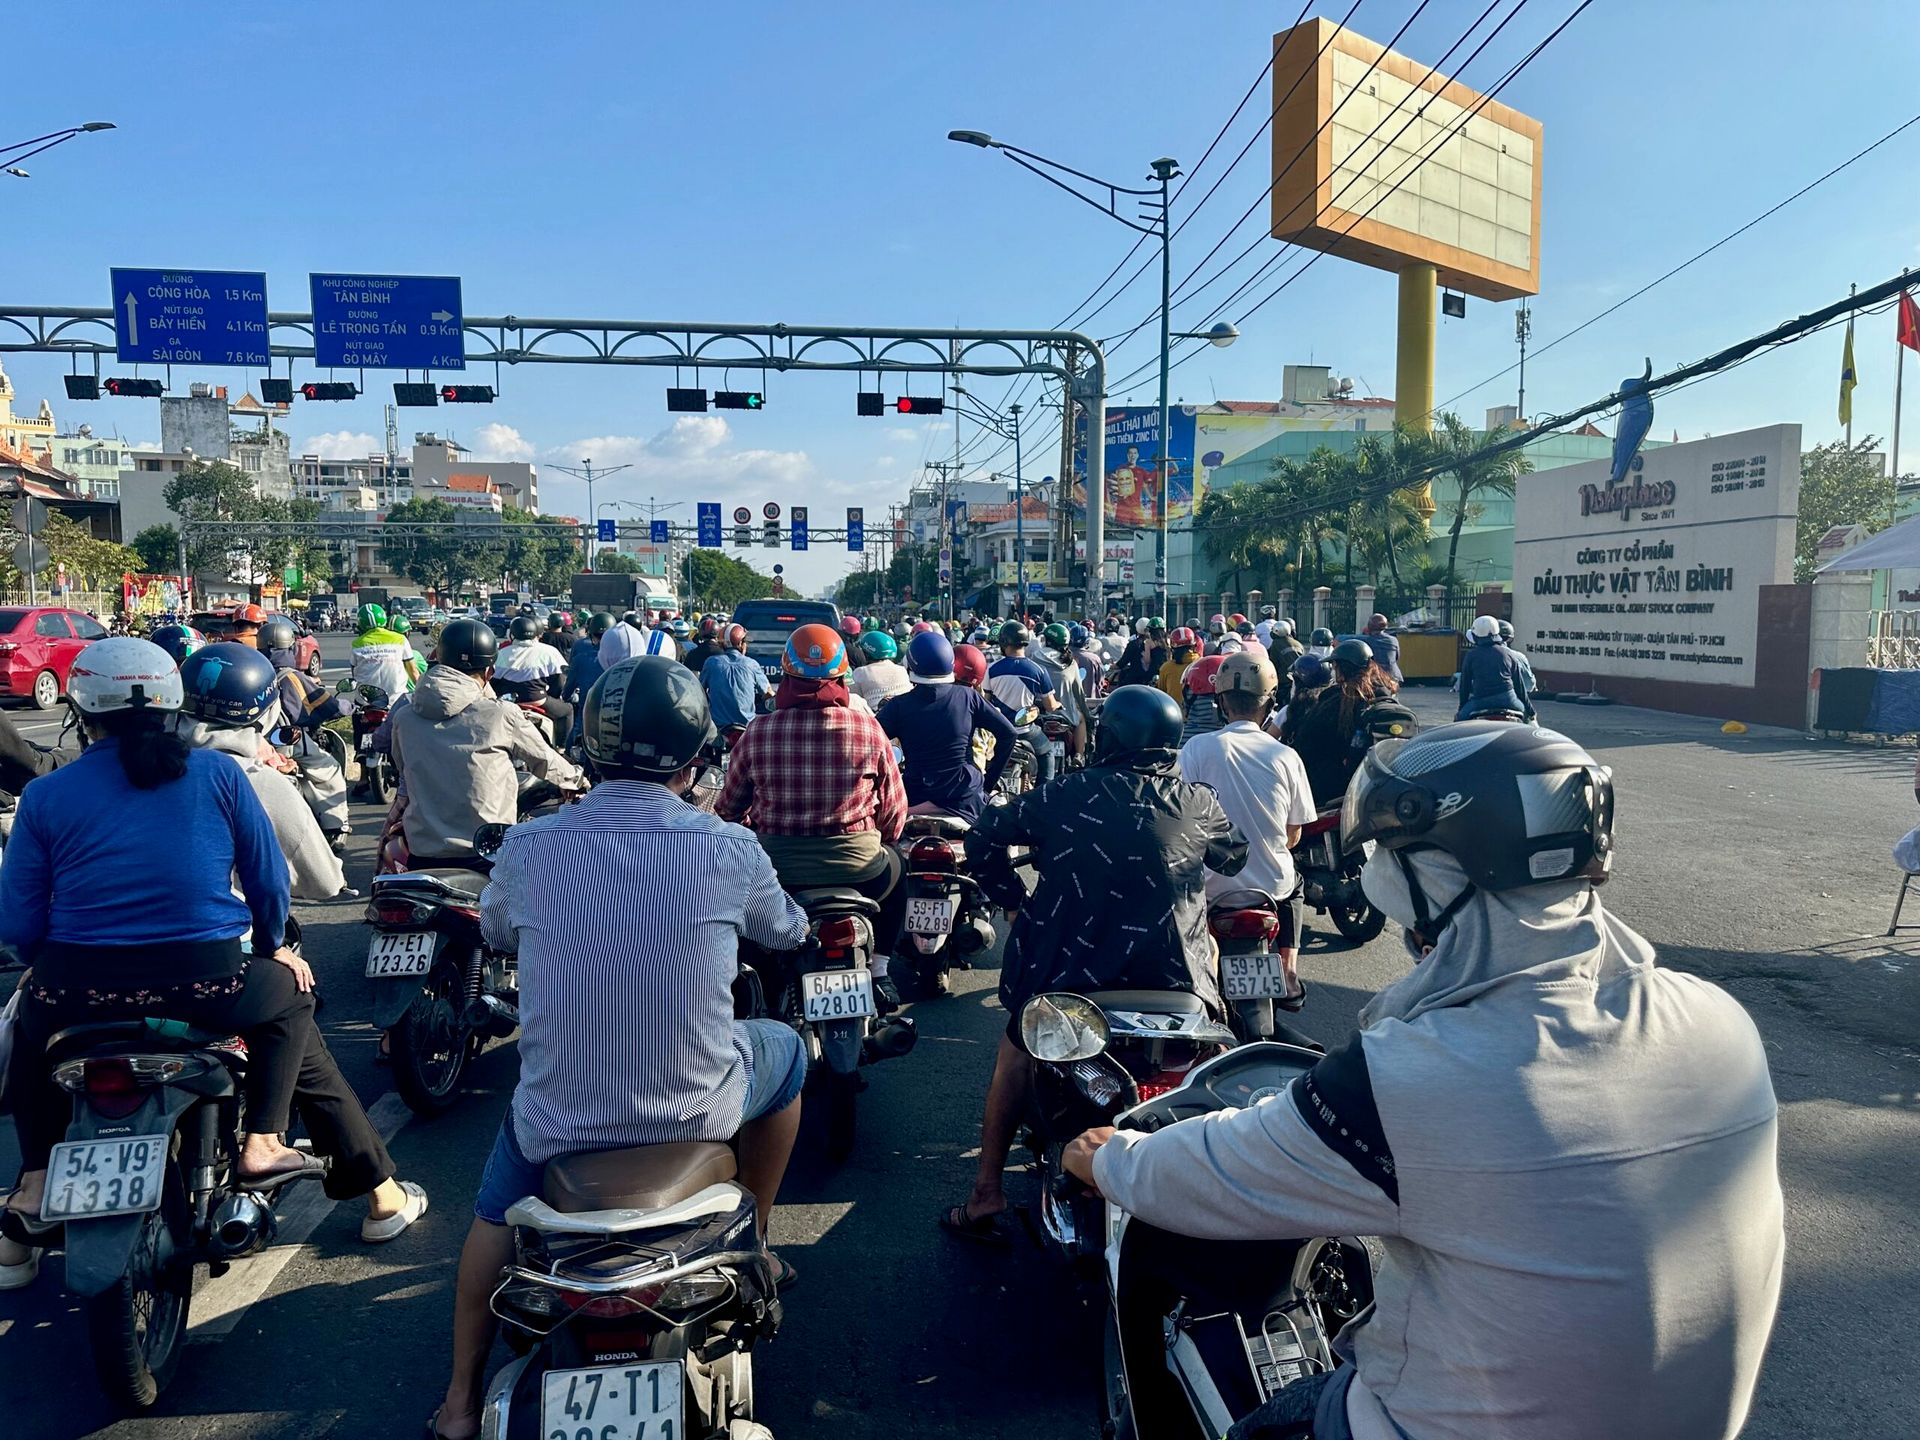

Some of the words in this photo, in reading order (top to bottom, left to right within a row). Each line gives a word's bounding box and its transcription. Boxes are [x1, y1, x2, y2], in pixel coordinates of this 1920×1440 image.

[343, 278, 365, 288] CÔNG
[148, 285, 182, 300] CỘNG
[185, 285, 211, 300] HÒA
[224, 290, 239, 301] 1.5
[242, 290, 262, 301] Km
[334, 289, 358, 303] TÂN
[361, 289, 390, 304] BÌNH
[163, 304, 181, 314] NÚT
[183, 306, 204, 315] GIAO
[150, 315, 174, 329] BẢY
[177, 316, 206, 330] HIỀN
[226, 320, 241, 331] 4.1
[244, 321, 264, 332] Km
[322, 320, 337, 333] LÊ
[339, 322, 380, 337] TRỌNG
[382, 319, 406, 335] TẤN
[420, 325, 436, 335] 0.9
[440, 325, 459, 336] Km
[169, 337, 181, 345] GA
[345, 341, 362, 350] NÚT
[365, 342, 384, 350] GIAO
[152, 348, 173, 360] SÀI
[176, 349, 201, 361] GÒN
[226, 351, 242, 362] 7.6
[246, 352, 266, 363] Km
[343, 352, 359, 364] GÒ
[362, 351, 388, 365] MÂY
[432, 355, 439, 366] 4
[442, 356, 460, 366] Km
[1122, 415, 1140, 432] THÁI
[1136, 430, 1150, 442] ZINC
[1712, 462, 1724, 472] ISO
[1712, 474, 1724, 482] ISO
[1711, 484, 1723, 494] ISO
[1641, 511, 1658, 522] Since
[1577, 548, 1605, 564] CÔNG
[1607, 549, 1622, 563] TY
[1623, 539, 1640, 562] CỔ
[1642, 540, 1674, 560] PHẦN
[1534, 568, 1562, 595] DẦU
[1565, 570, 1605, 599] THỰC
[1610, 567, 1640, 599] VẬT
[1644, 566, 1680, 592] TÂN
[1686, 563, 1733, 592] BÌNH
[1648, 603, 1674, 613] STOCK
[914, 901, 944, 916] 59-F1
[908, 916, 948, 931] 642.89
[381, 935, 424, 953] 77-E1
[373, 954, 427, 974] 123.26
[1230, 957, 1271, 975] 59-P1
[814, 974, 859, 995] 64-D1
[1227, 976, 1281, 995] 557.45
[810, 993, 867, 1016] 428.01
[99, 1126, 131, 1134] HONDA
[66, 1142, 149, 1178] 54-V9
[63, 1176, 145, 1214] 1338
[595, 1352, 638, 1361] HONDA
[564, 1368, 659, 1421] 47-T1
